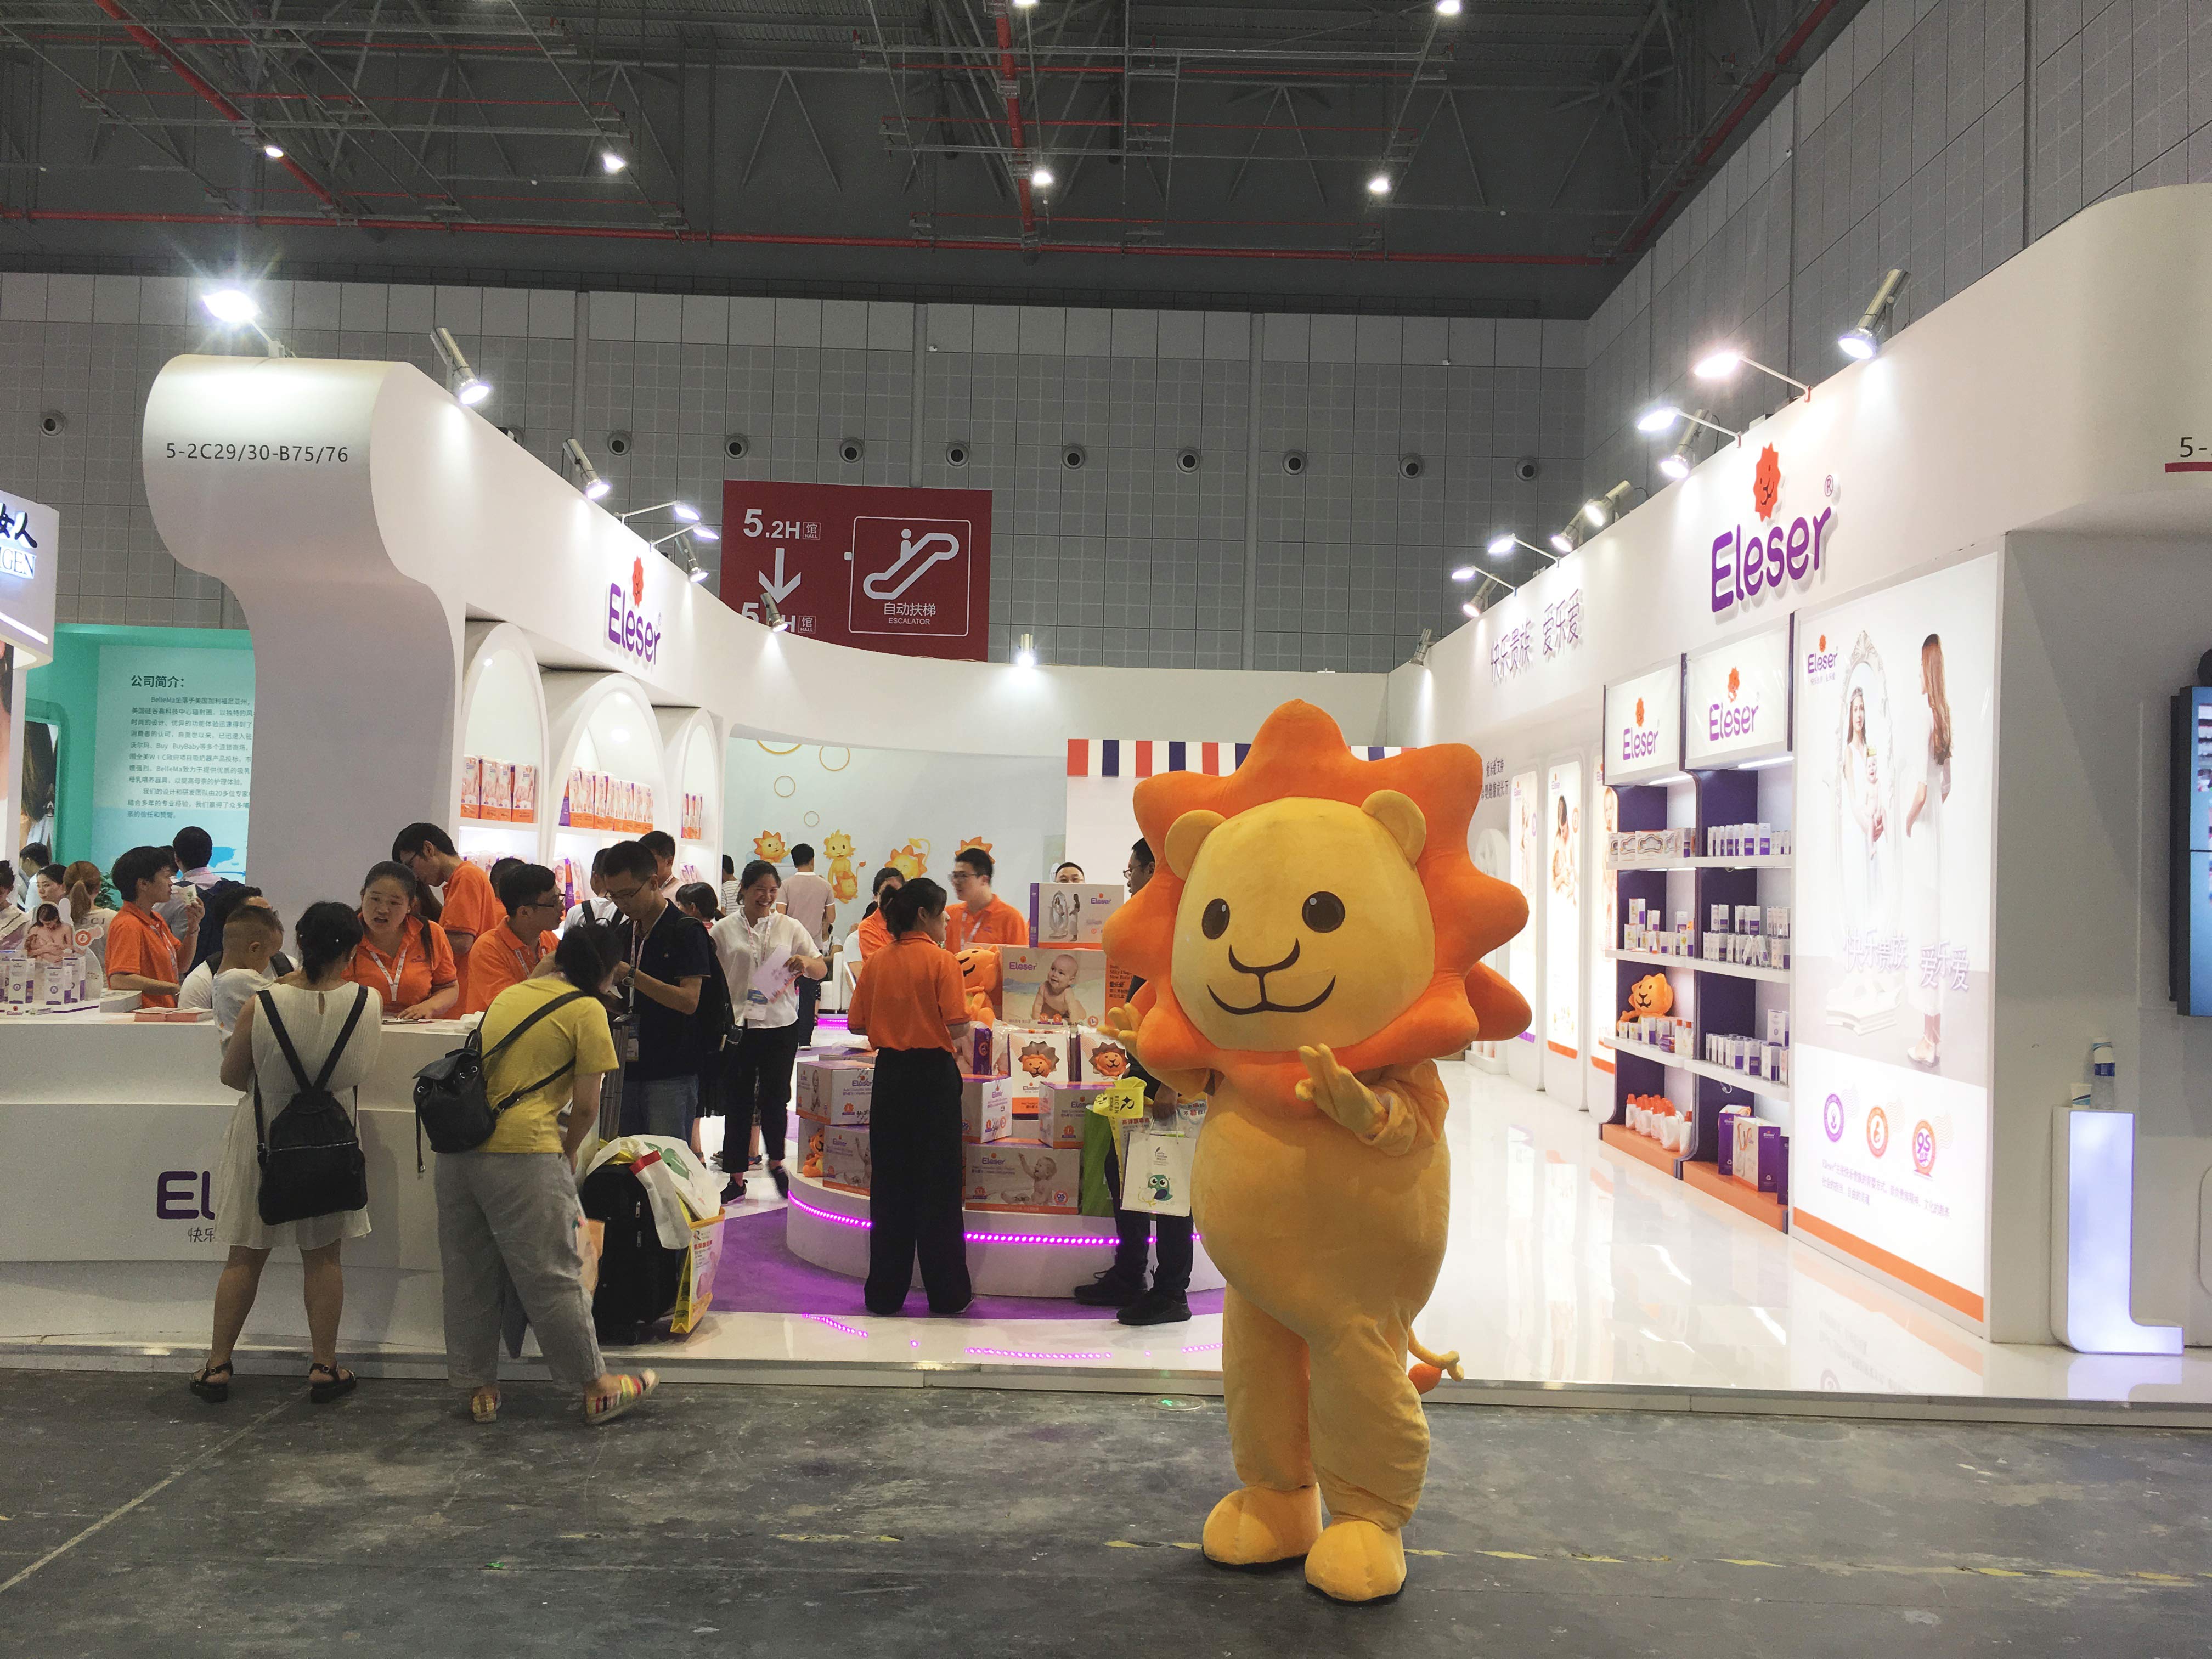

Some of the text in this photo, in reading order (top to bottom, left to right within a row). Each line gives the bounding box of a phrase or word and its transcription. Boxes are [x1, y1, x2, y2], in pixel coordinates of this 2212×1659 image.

[166, 442, 349, 463] 5-2C29/30-B75/76
[2180, 437, 2212, 458] 5-
[0, 549, 36, 577] GEN
[1711, 506, 1831, 613] Eleser
[883, 602, 936, 617] 自动扶梯
[608, 582, 661, 665] Eleser
[888, 617, 930, 625] ESCALATOR
[1808, 652, 1838, 674] Eleser
[1709, 703, 1759, 742] Eleser
[1622, 726, 1659, 760] Eleser
[1009, 962, 1036, 970] Eleser
